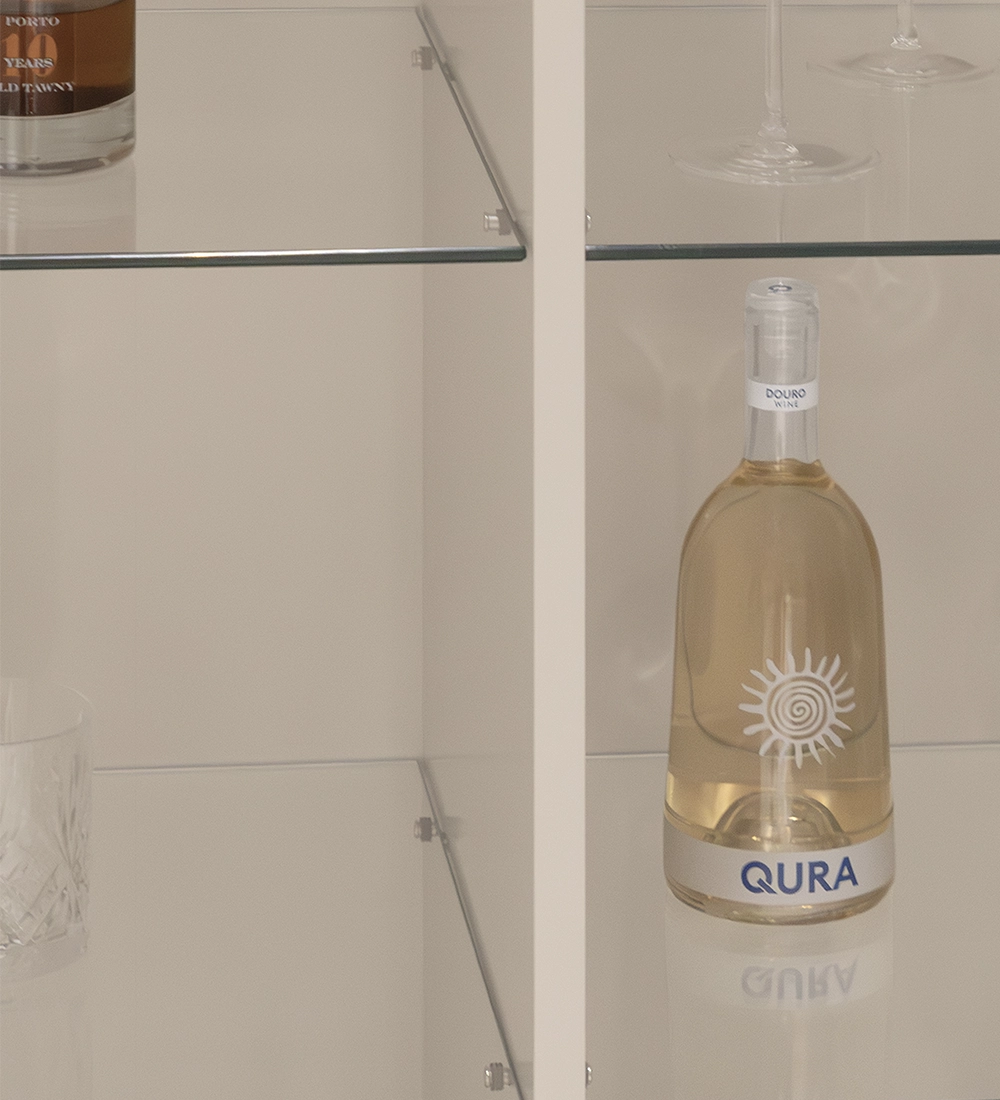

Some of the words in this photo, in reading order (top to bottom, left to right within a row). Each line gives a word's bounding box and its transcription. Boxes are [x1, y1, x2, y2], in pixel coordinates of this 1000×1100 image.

[5, 16, 60, 27] PORTO
[0, 33, 58, 77] 10
[3, 57, 54, 68] YEARS
[0, 82, 19, 93] LD
[22, 81, 75, 93] TAWNY
[765, 388, 807, 399] DOURO
[774, 400, 799, 408] WINE
[741, 856, 859, 895] QURA
